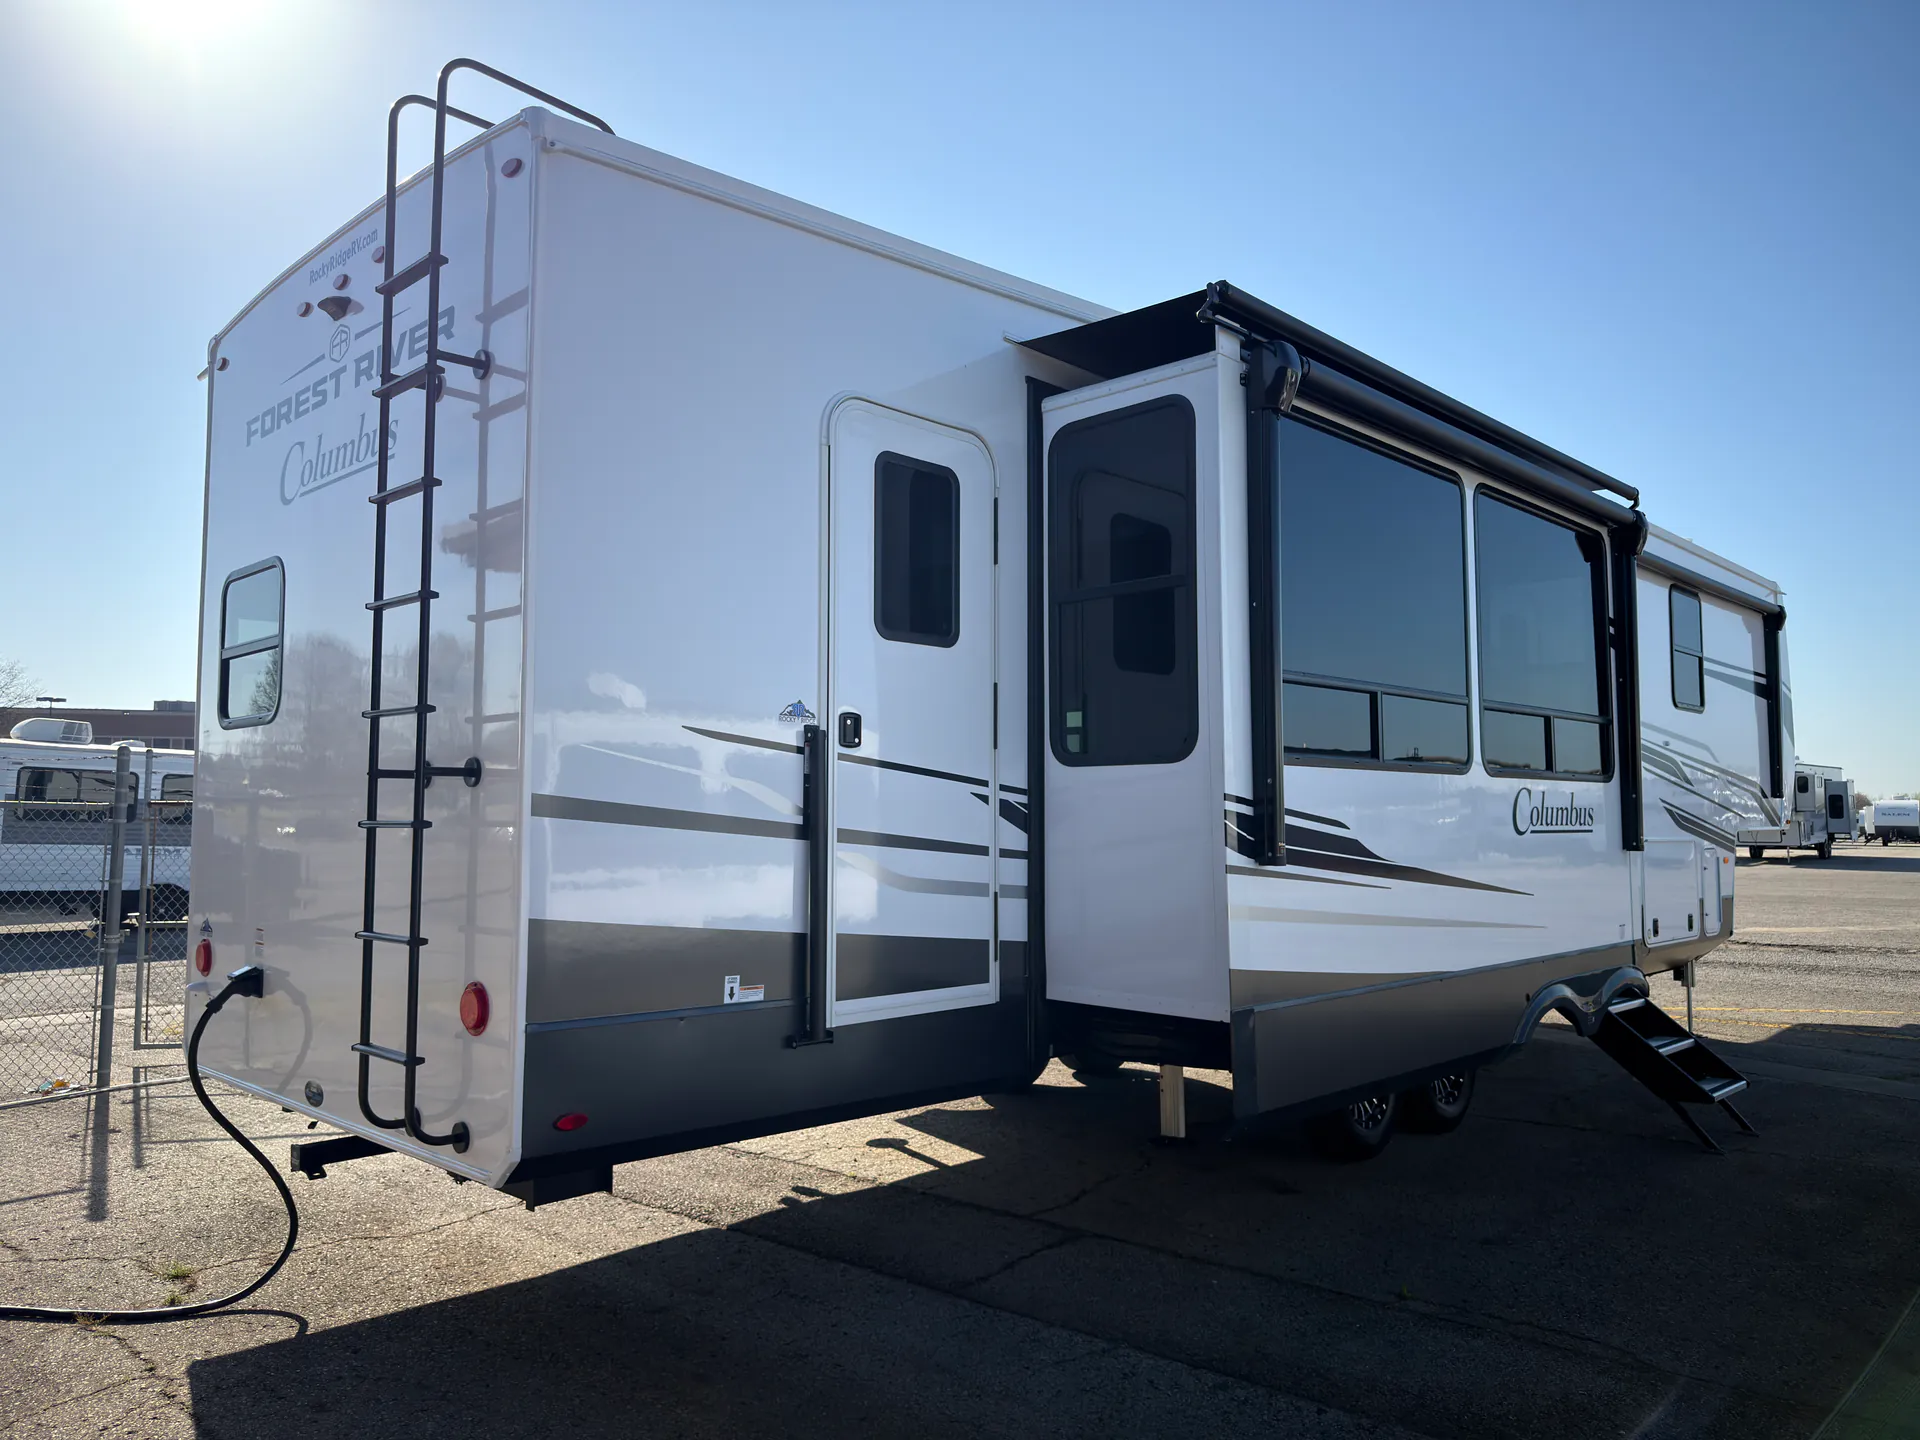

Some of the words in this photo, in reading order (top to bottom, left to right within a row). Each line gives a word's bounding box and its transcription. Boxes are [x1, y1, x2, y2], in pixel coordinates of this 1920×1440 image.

[309, 229, 378, 287] RockyRidgeRV.com
[246, 364, 347, 447] FOREST
[354, 305, 455, 388] RIVER
[1512, 787, 1594, 836] Columbus
